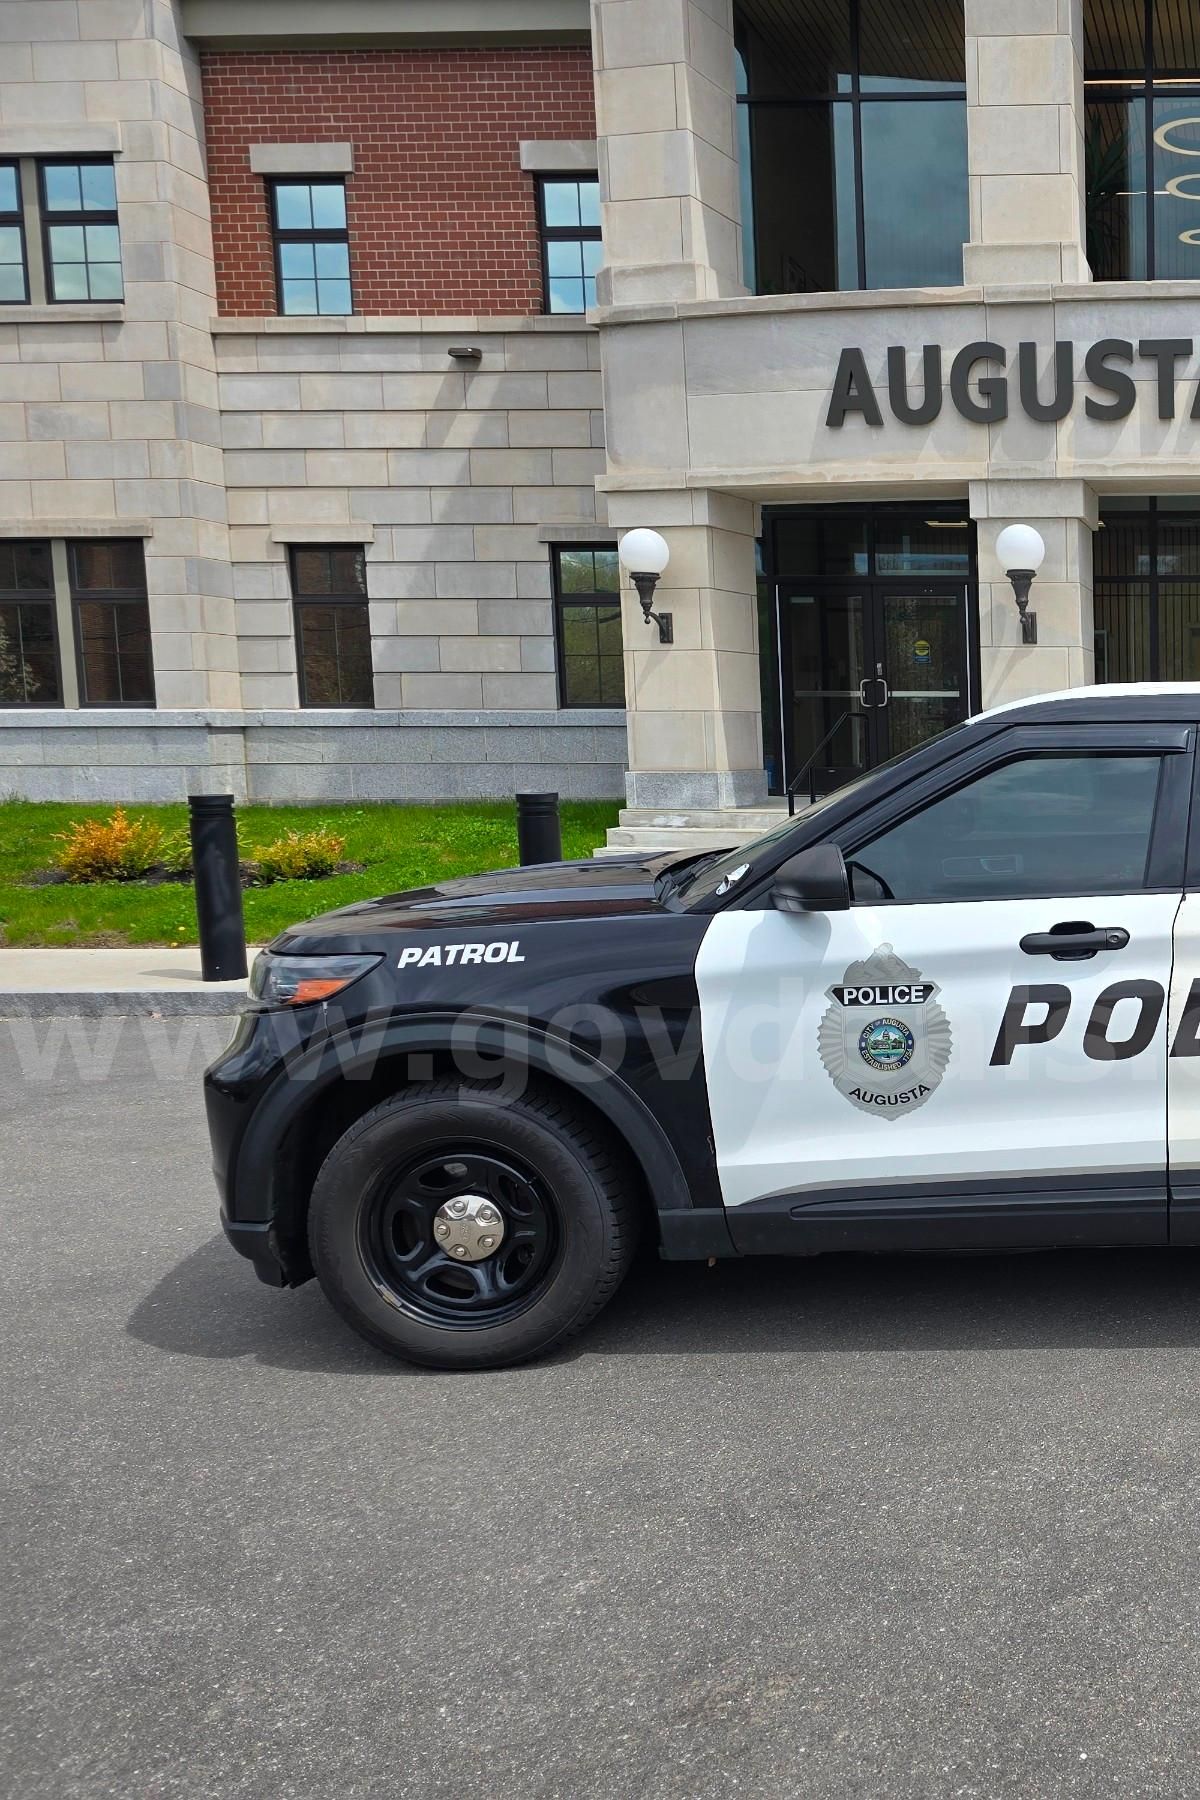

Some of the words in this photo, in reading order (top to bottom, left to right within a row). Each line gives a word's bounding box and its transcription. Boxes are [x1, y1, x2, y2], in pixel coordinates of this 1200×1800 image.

[397, 941, 526, 969] PATROL
[843, 985, 924, 1005] POLICE
[862, 1023, 875, 1039] CITY
[882, 1018, 910, 1037] AUGUSTA
[861, 1049, 902, 1070] ESTABLISHED
[849, 1083, 931, 1106] AUGUSTA
